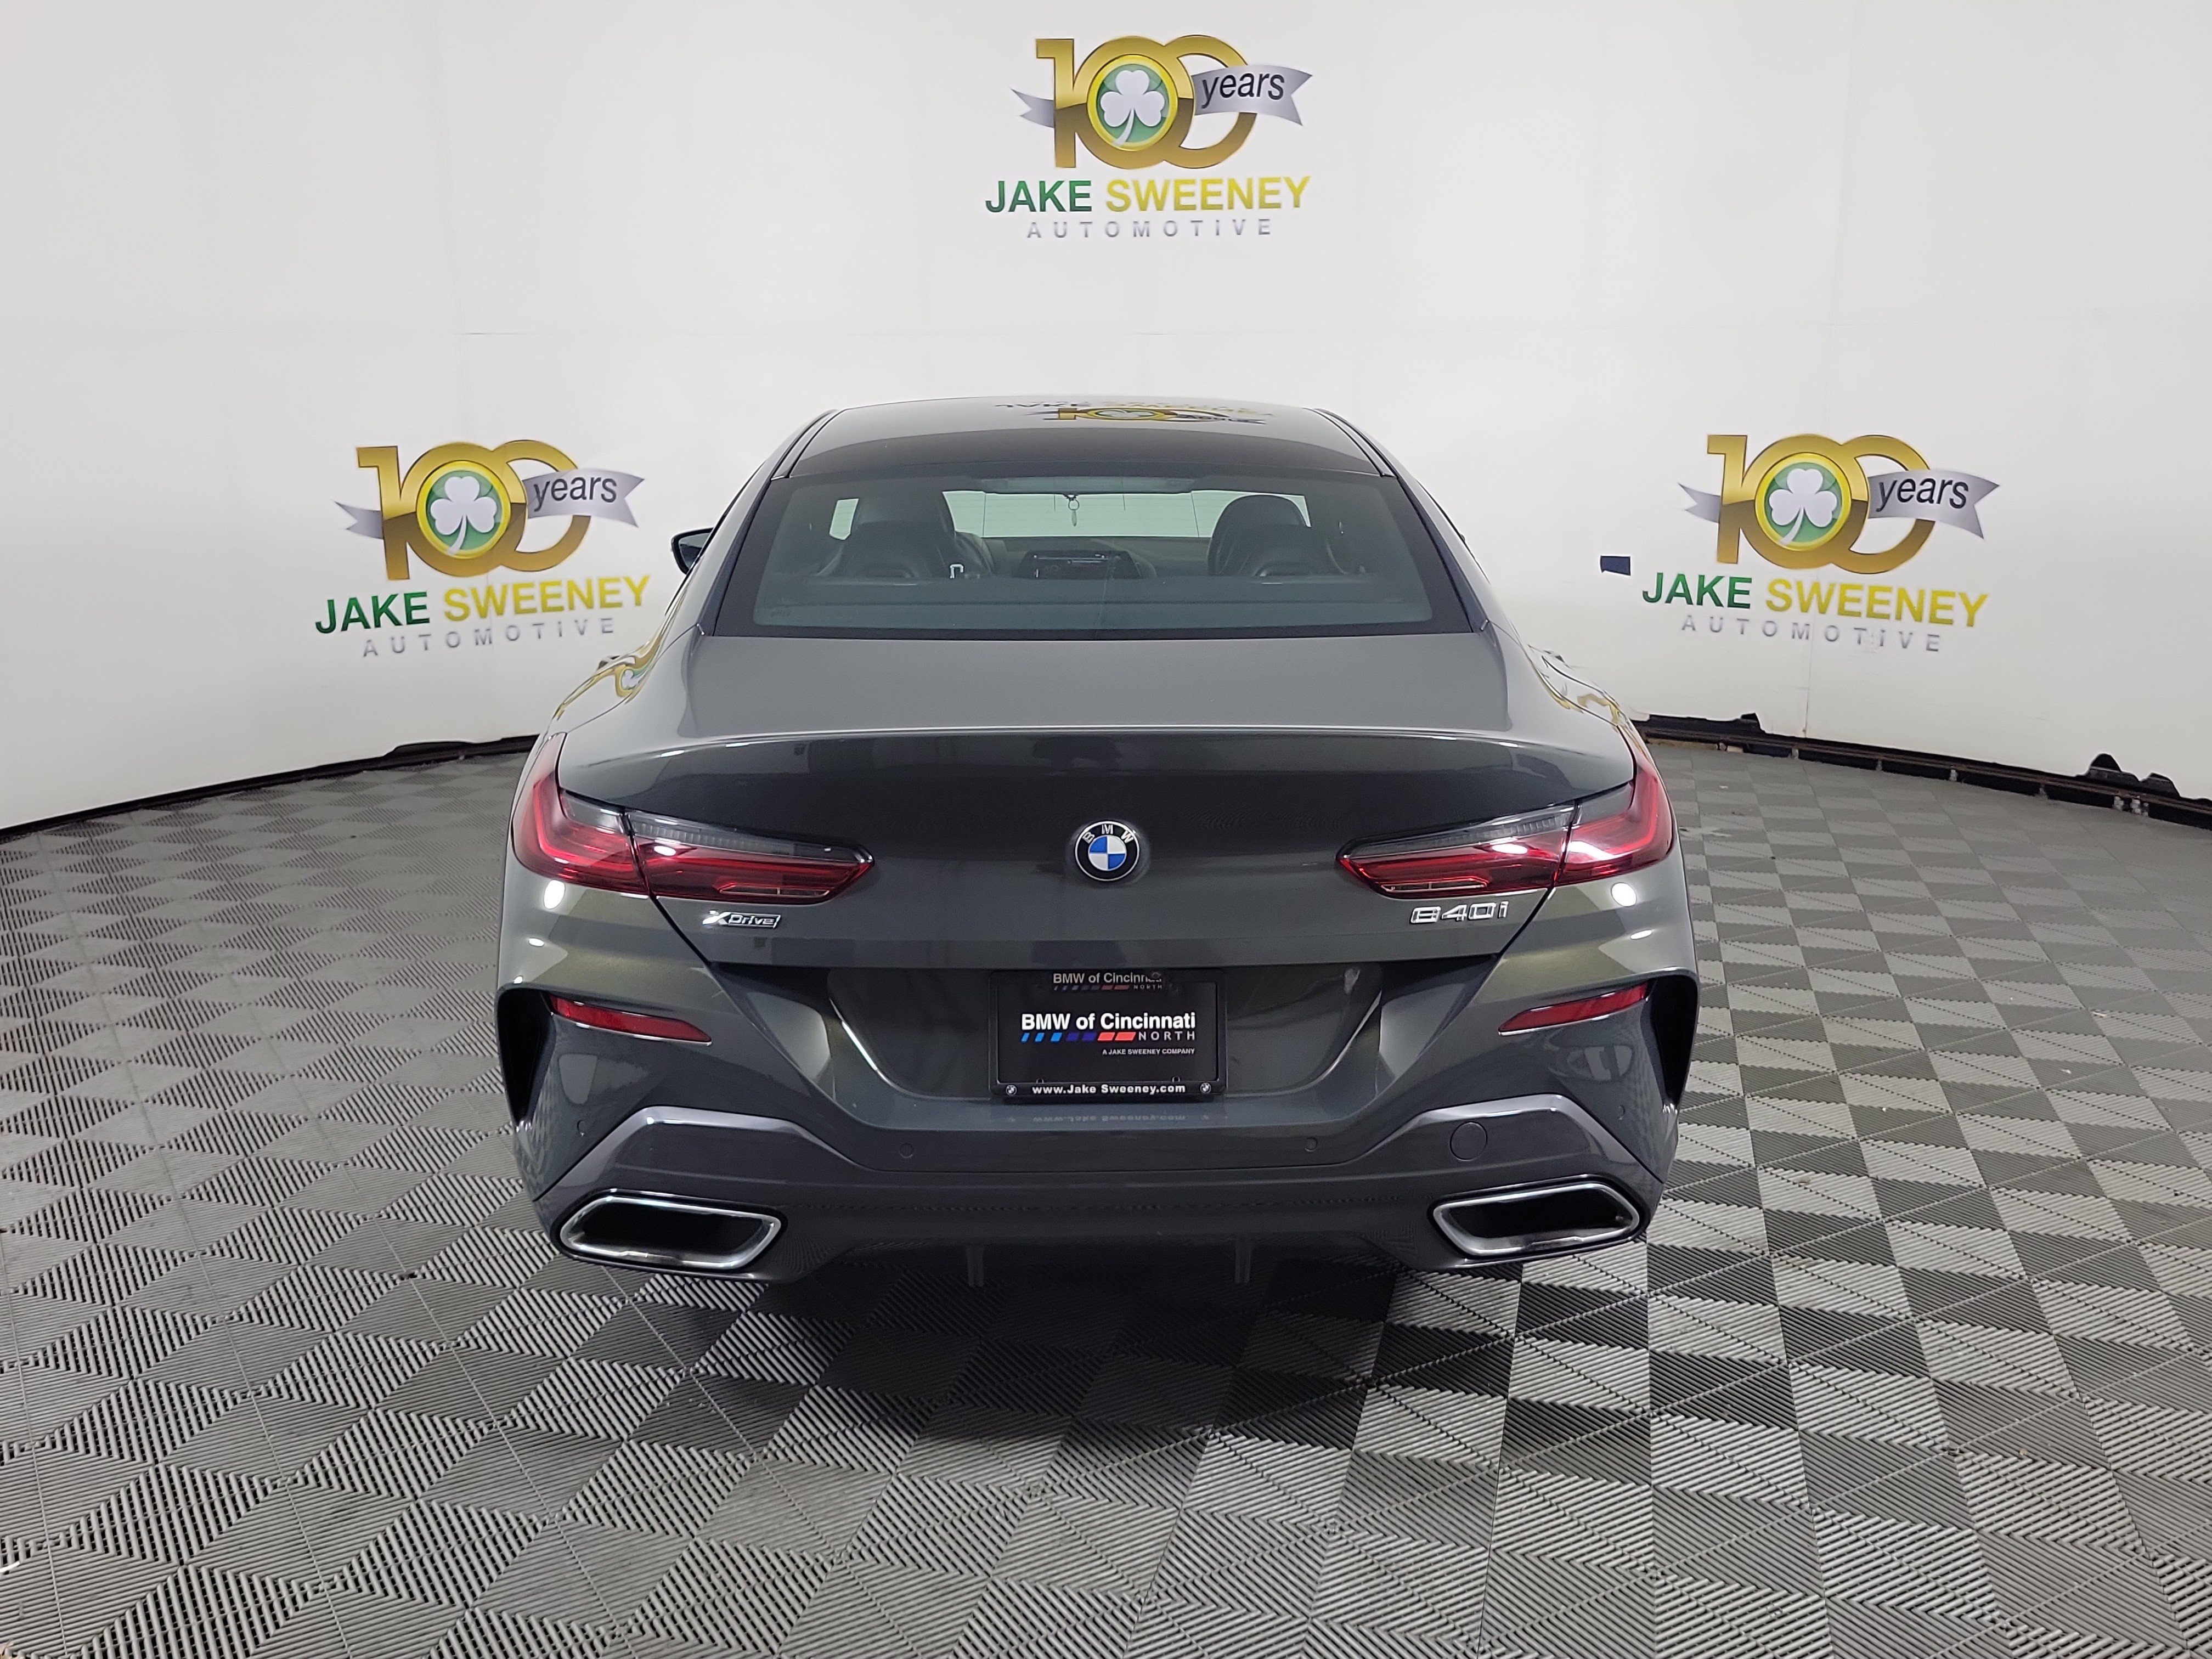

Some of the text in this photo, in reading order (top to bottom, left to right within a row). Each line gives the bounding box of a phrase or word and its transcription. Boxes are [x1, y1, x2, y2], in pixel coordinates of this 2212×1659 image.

[1035, 35, 1285, 170] 100 years
[985, 175, 1311, 213] JAKE SWEENEY
[1027, 219, 1272, 239] AUTOMOTIVE
[356, 439, 617, 581] 100 years
[1707, 434, 1970, 574] 100 years
[315, 574, 650, 634] JAKE SWEENEY
[1642, 572, 1988, 628] JAKE SWEENEY
[363, 618, 614, 658] AUTOMOTIVE
[1680, 614, 1941, 652] AUTOMOTIVE
[1082, 823, 1134, 844] BMW
[1410, 901, 1509, 924] 840i
[1053, 973, 1085, 984] BMW
[1087, 972, 1101, 983] of
[1022, 1012, 1195, 1030] BMW of Cincinnati
[1138, 1031, 1195, 1041] NORTH
[1032, 1084, 1186, 1095] www.Jake Sweeney.com
